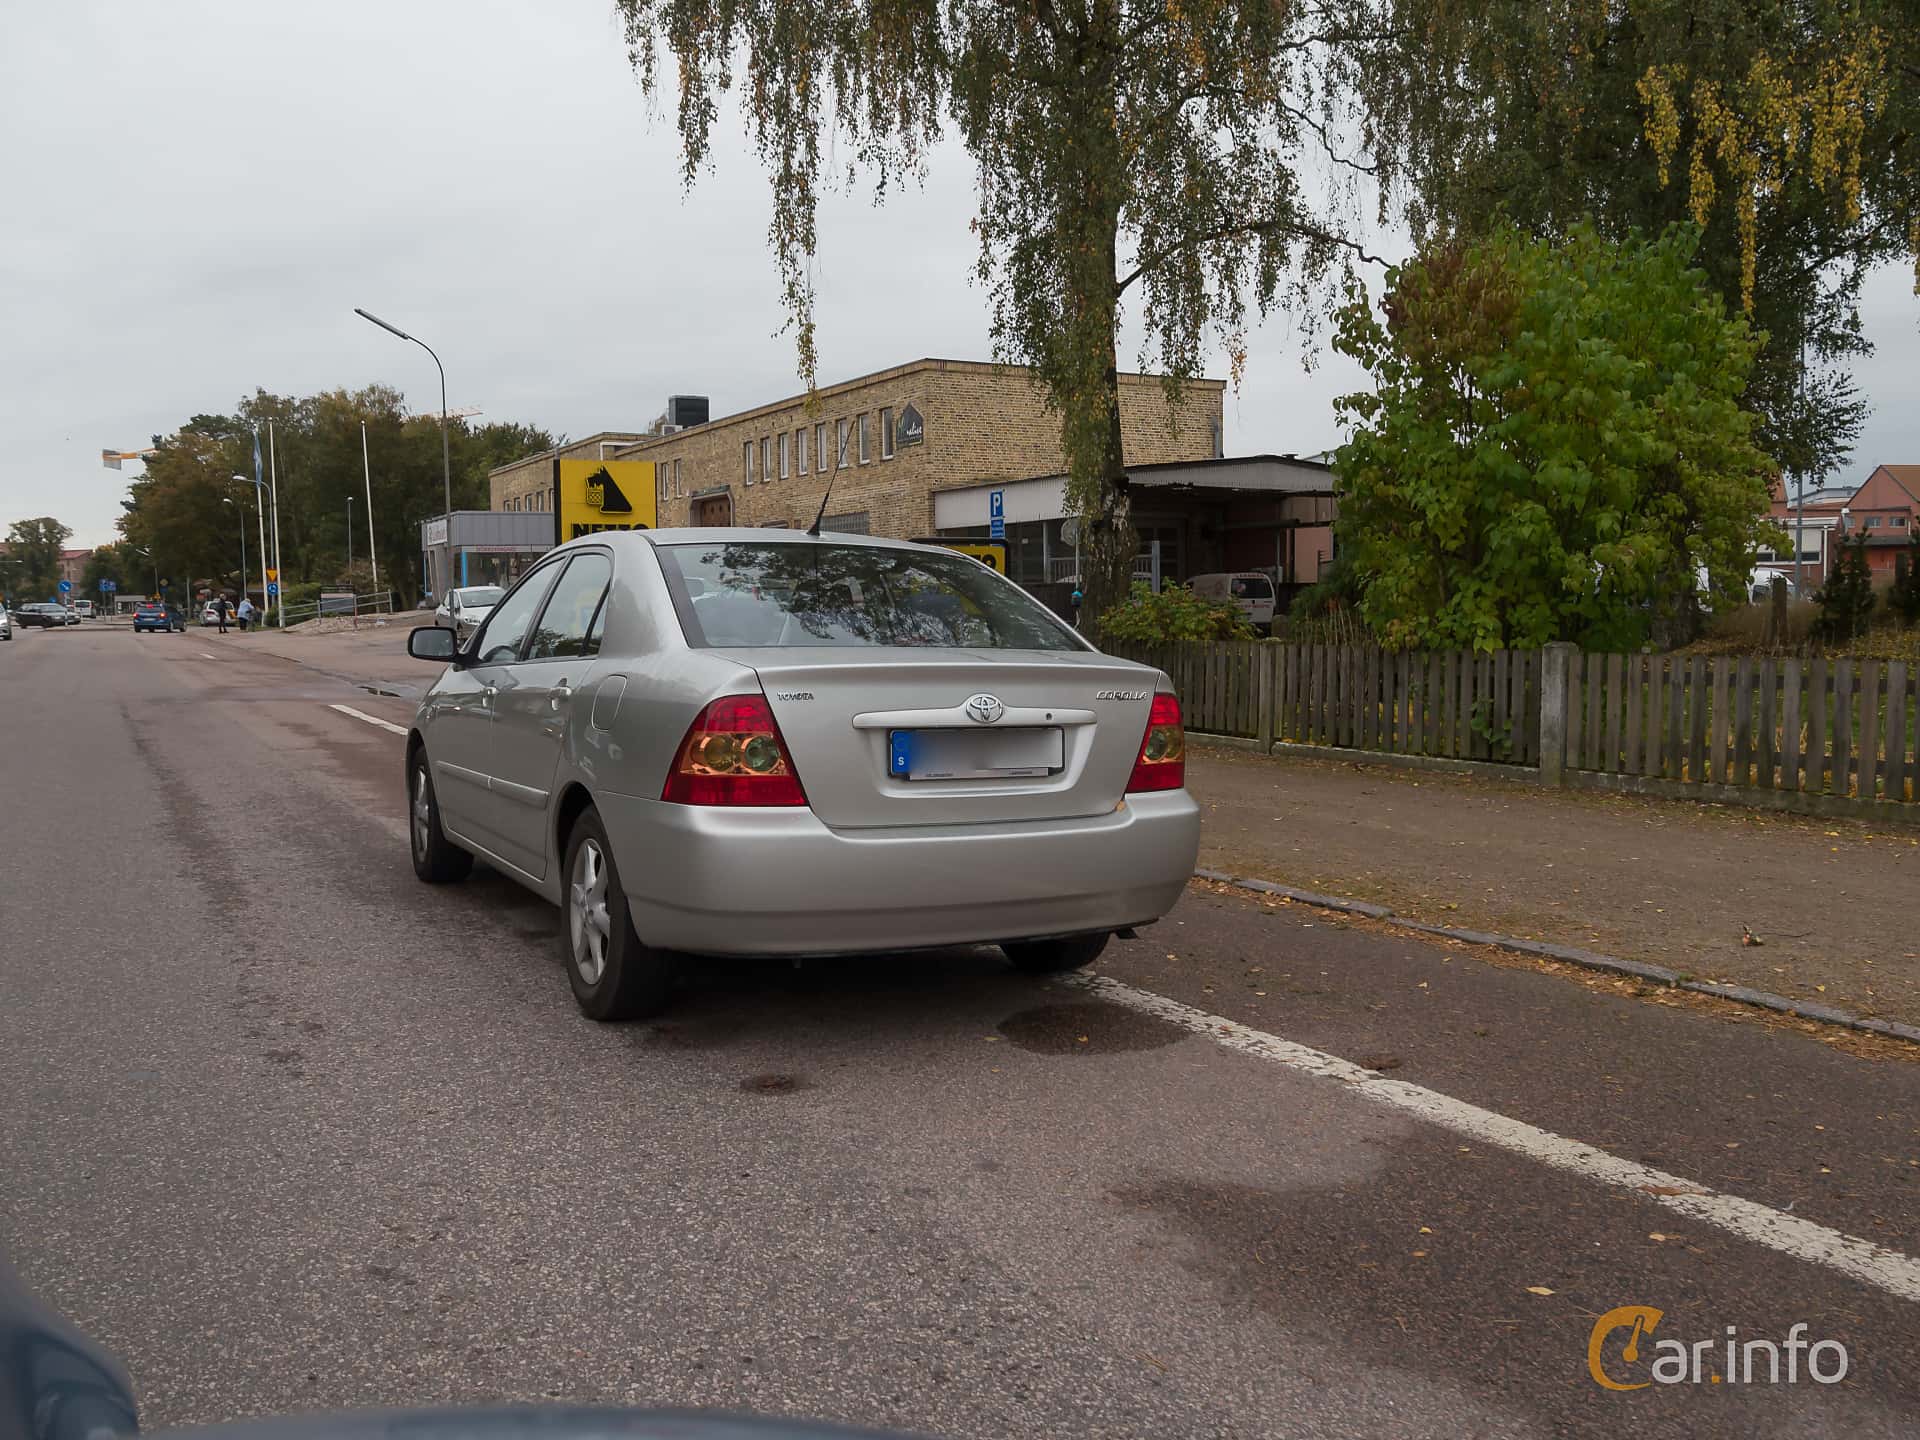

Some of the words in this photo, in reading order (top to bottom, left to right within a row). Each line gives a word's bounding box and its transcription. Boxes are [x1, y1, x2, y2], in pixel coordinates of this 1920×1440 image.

[993, 494, 1001, 516] P
[777, 691, 814, 701] TOYOTA
[1096, 690, 1148, 701] COROLLA
[898, 756, 905, 766] S
